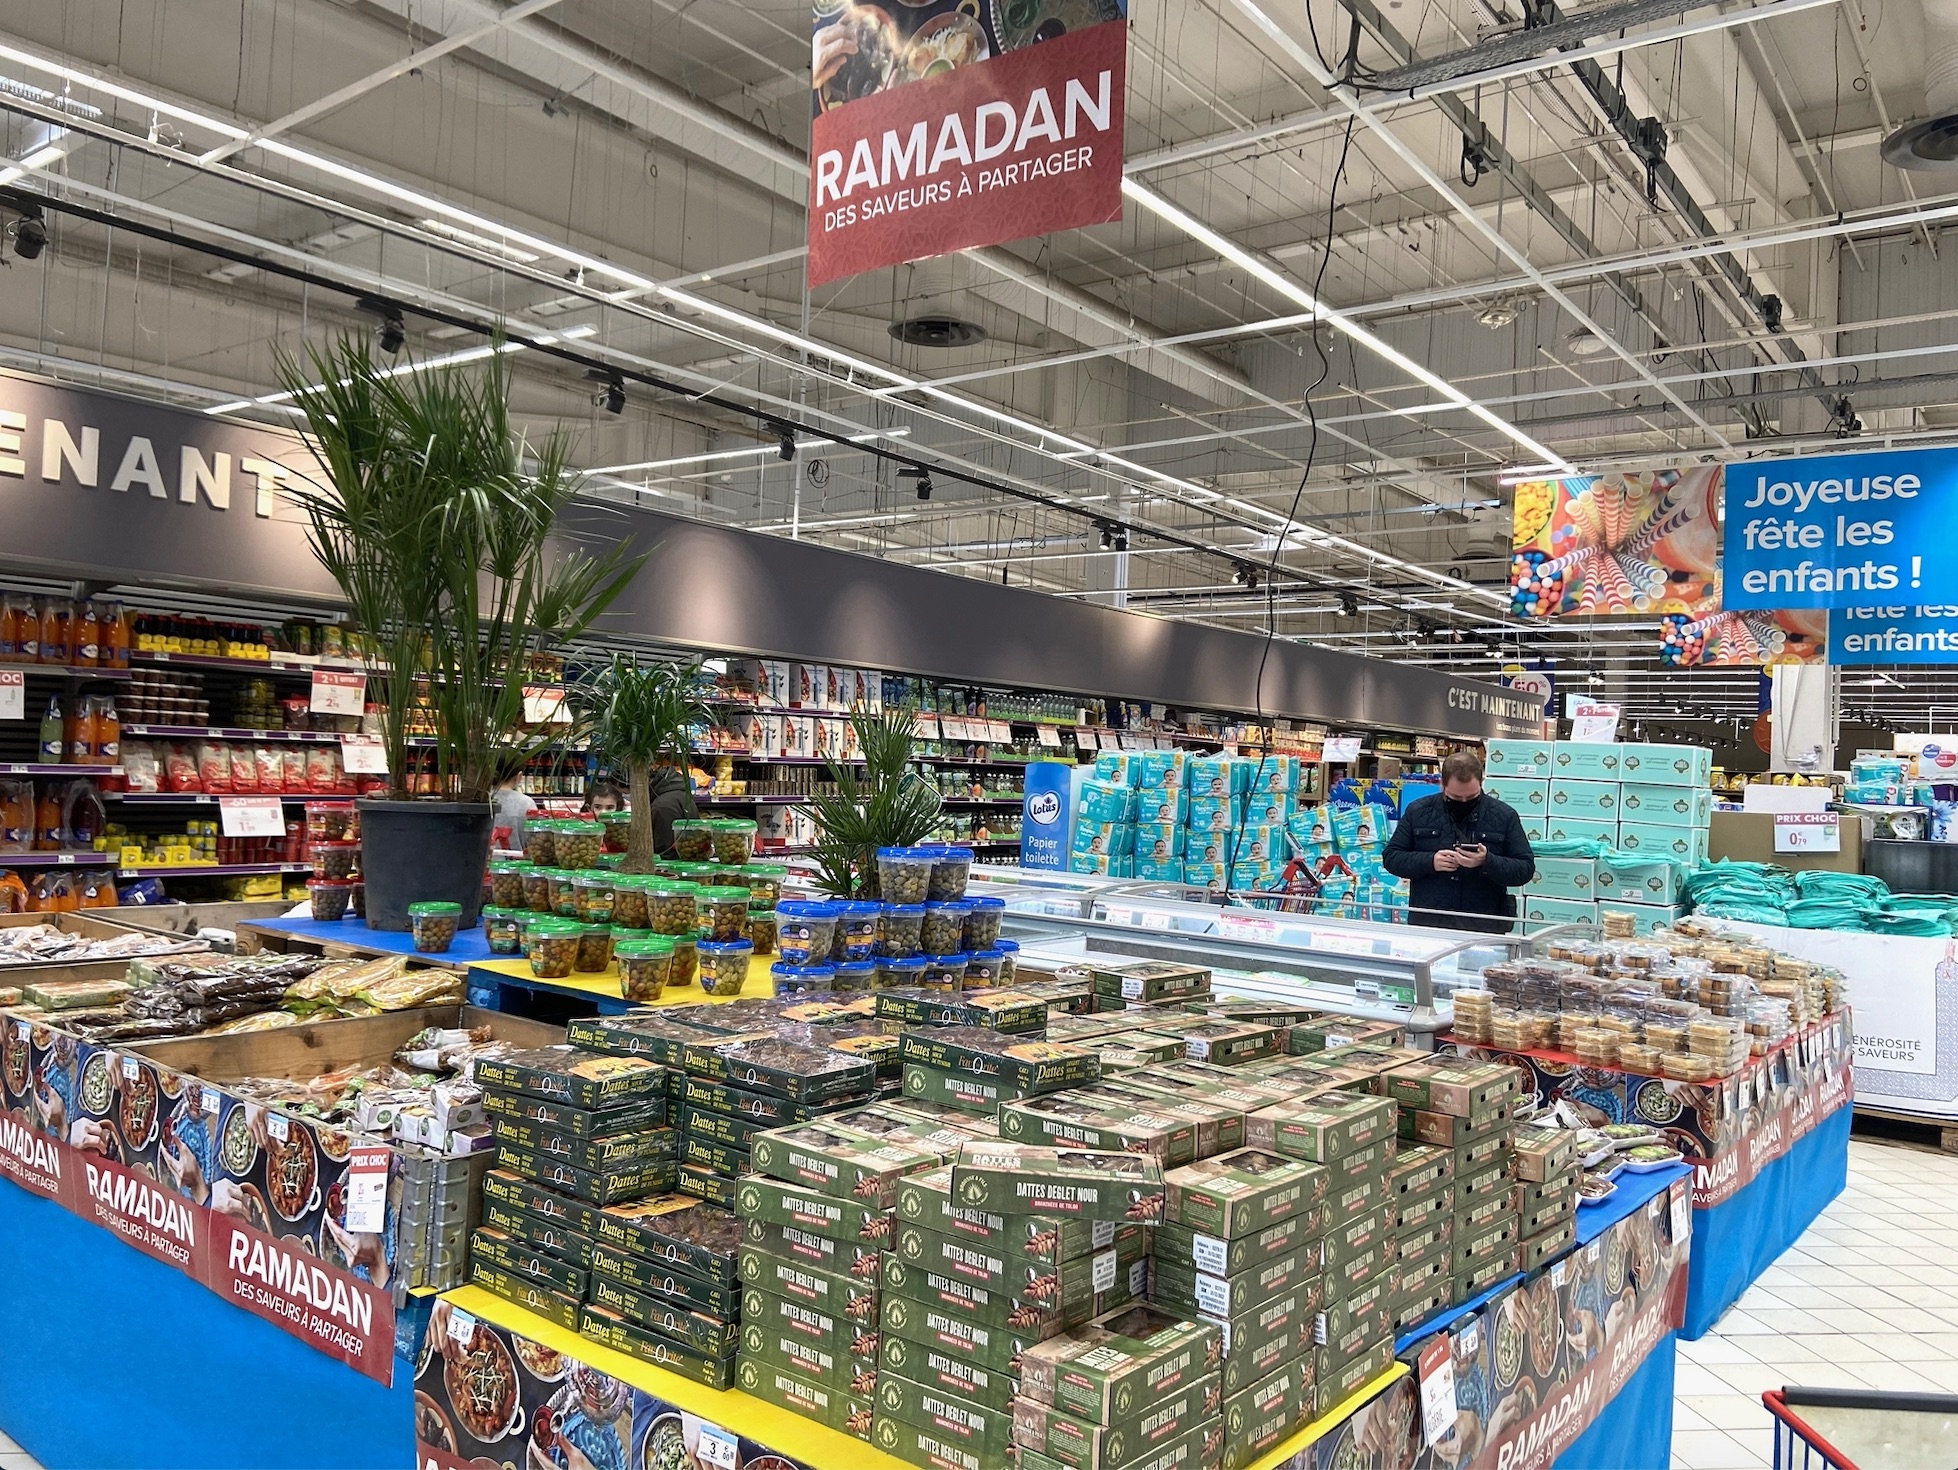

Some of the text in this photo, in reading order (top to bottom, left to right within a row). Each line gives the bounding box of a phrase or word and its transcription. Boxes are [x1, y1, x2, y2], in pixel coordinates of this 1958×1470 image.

[815, 69, 1112, 208] RAMADAN
[824, 146, 1093, 232] DES SAVEURS À PARTAGER
[1744, 473, 1921, 513] Joyeuse
[1743, 515, 1894, 550] fête les
[1741, 560, 1898, 594] enfants
[1843, 627, 1958, 652] enfants
[1448, 687, 1541, 722] C'EST MAINTENANT
[1776, 813, 1836, 823] PRIX CHOC
[1028, 835, 1058, 850] Papier
[1025, 851, 1059, 865] toilette
[882, 998, 905, 1013] Dattes
[570, 1025, 593, 1041] Dattes
[904, 1039, 931, 1057] Dattes
[1858, 1047, 1914, 1061] SAVEURS
[685, 1050, 708, 1068] Dattes
[480, 1062, 503, 1079] Dattes
[1037, 1064, 1064, 1082] Dattes
[687, 1082, 711, 1101] Dattes
[691, 1111, 716, 1132] Dattes
[603, 1139, 635, 1159] Dattes
[351, 1154, 387, 1166] PRIX CHOC
[25, 1169, 59, 1194] PARTAGER
[486, 1178, 508, 1197] Dattes
[608, 1175, 641, 1194] Dattes
[1016, 1182, 1098, 1203] DATTES DEGLET NOUR
[86, 1162, 195, 1246] RAMADAN
[95, 1203, 190, 1265] DES SAVEURS À PARTAGER
[599, 1218, 625, 1240] Dattes
[229, 1229, 373, 1336] RAMADAN
[598, 1283, 623, 1305] Dattes
[233, 1278, 363, 1357] DES SAVEURS À PARTAGER
[583, 1315, 610, 1338] Dattes
[1496, 1369, 1595, 1470] RAMADAN
